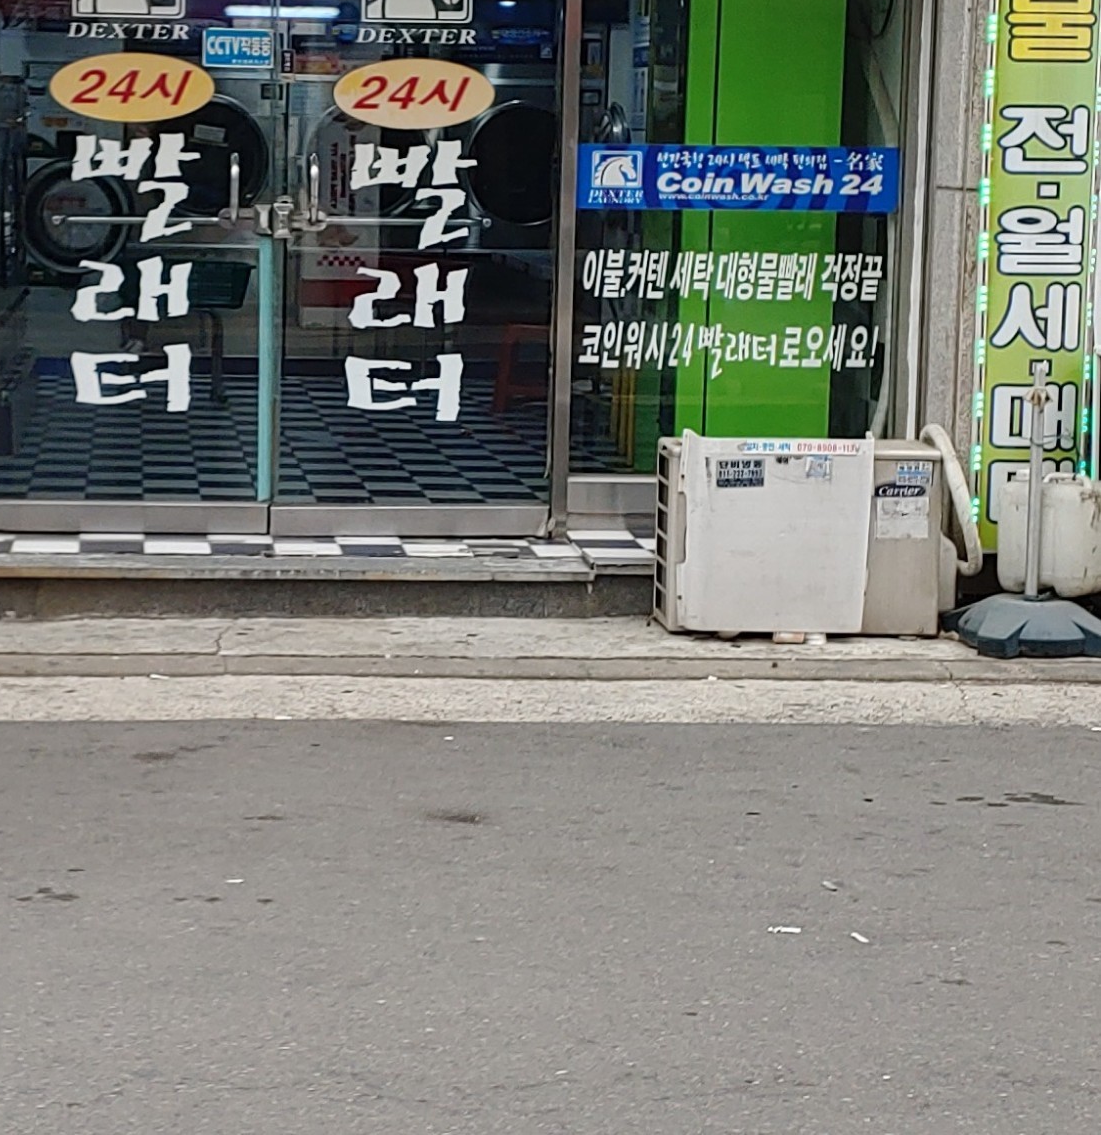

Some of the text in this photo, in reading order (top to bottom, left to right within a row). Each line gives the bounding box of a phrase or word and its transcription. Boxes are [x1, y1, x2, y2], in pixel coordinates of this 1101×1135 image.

[67, 21, 190, 40] DEXTER
[356, 27, 477, 45] DEXTER
[70, 69, 193, 106] 24시
[352, 75, 471, 112] 24시
[657, 171, 884, 195] Coin Wash 24
[69, 132, 201, 413] 빨래터
[345, 140, 477, 422] 빨래터
[669, 251, 714, 301] 세탁
[715, 251, 818, 301] 대형물빨래
[821, 252, 883, 302] 걱정끝
[879, 485, 920, 496] Carrier
